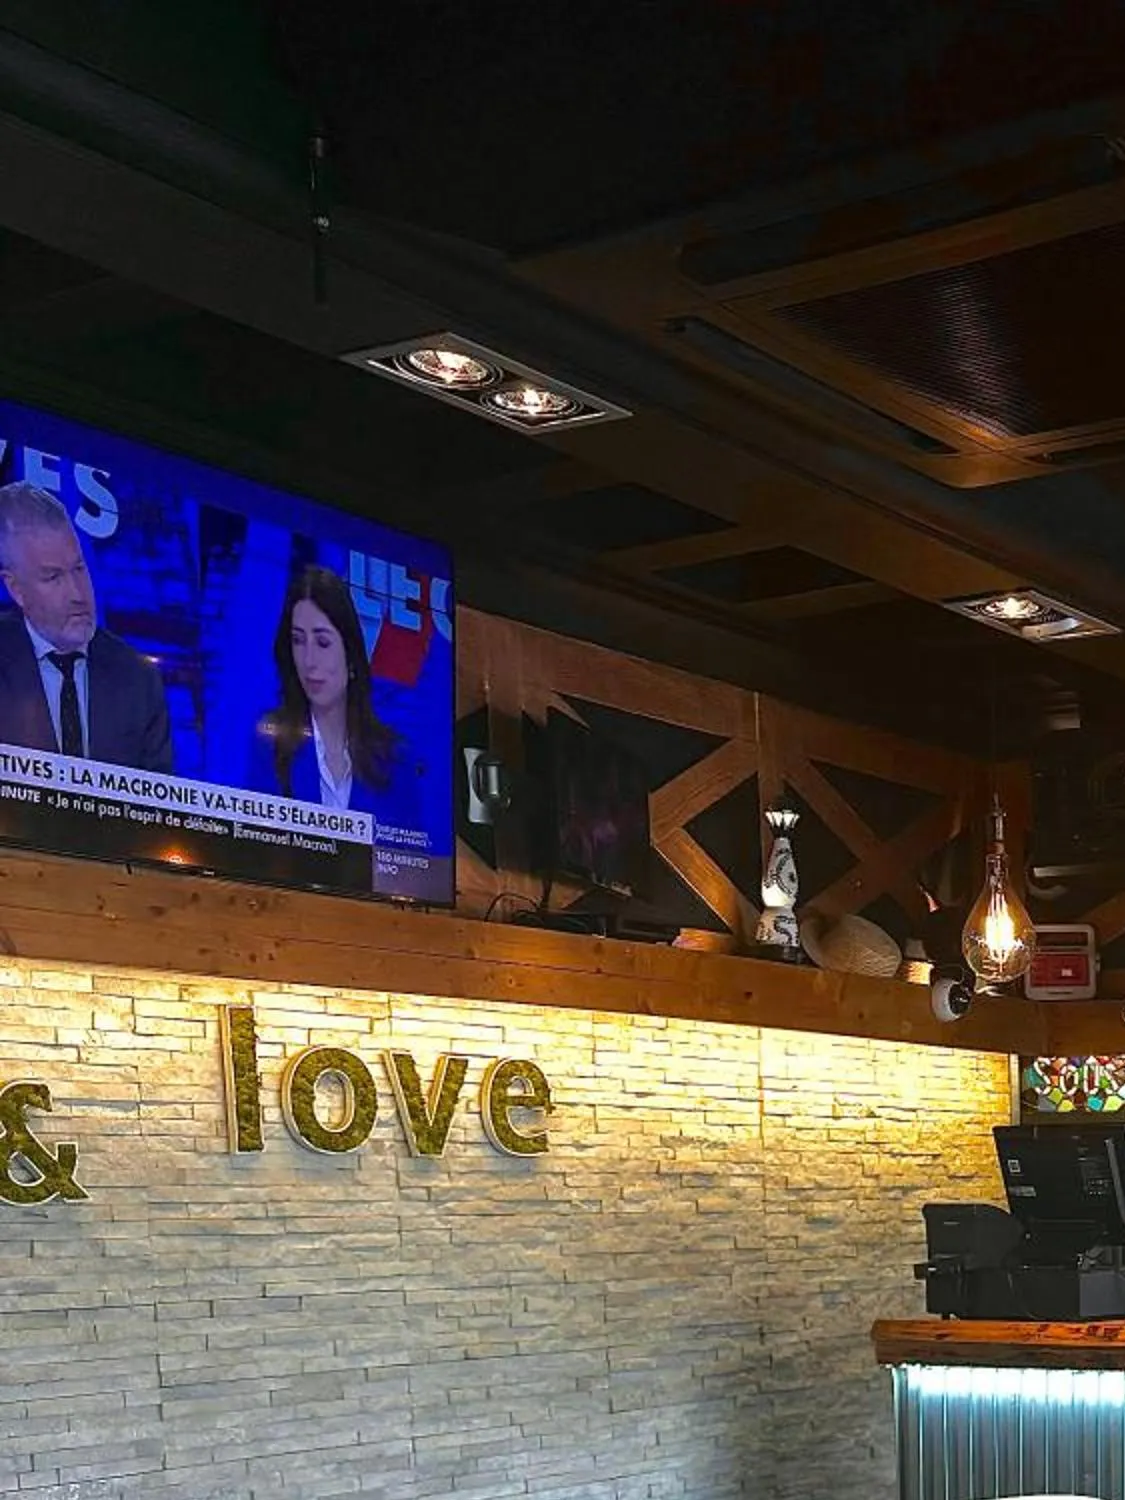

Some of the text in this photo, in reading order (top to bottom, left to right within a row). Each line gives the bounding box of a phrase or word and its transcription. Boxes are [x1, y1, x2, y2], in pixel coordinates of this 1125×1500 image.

[71, 767, 93, 787] LA
[100, 772, 198, 805] MACRONIE
[202, 791, 275, 820] VA-T-ELLE
[99, 804, 121, 818] pas
[165, 813, 181, 827] de
[0, 1003, 555, 1203] & love
